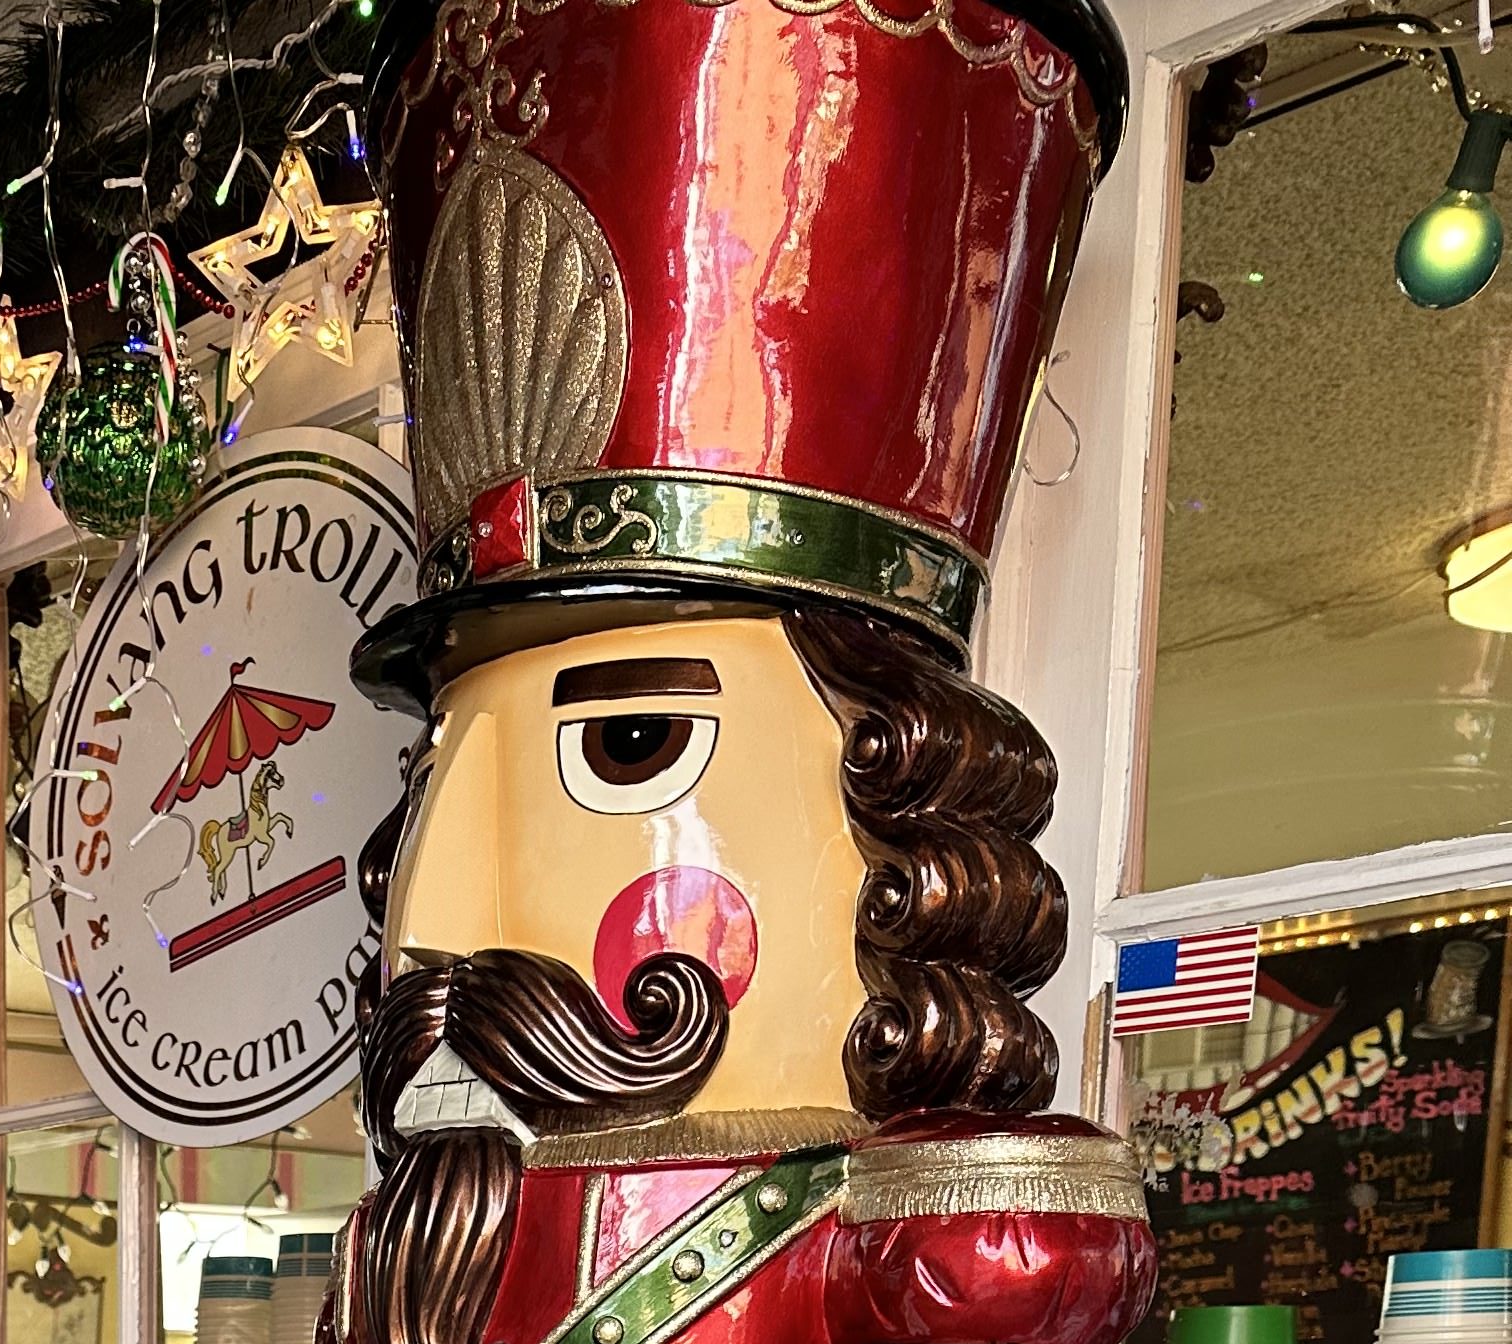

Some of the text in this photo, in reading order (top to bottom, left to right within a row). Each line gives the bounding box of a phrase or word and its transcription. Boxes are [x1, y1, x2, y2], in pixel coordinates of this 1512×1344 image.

[236, 498, 409, 630] TROLL
[95, 964, 149, 1048] ice
[151, 1018, 307, 1088] cream
